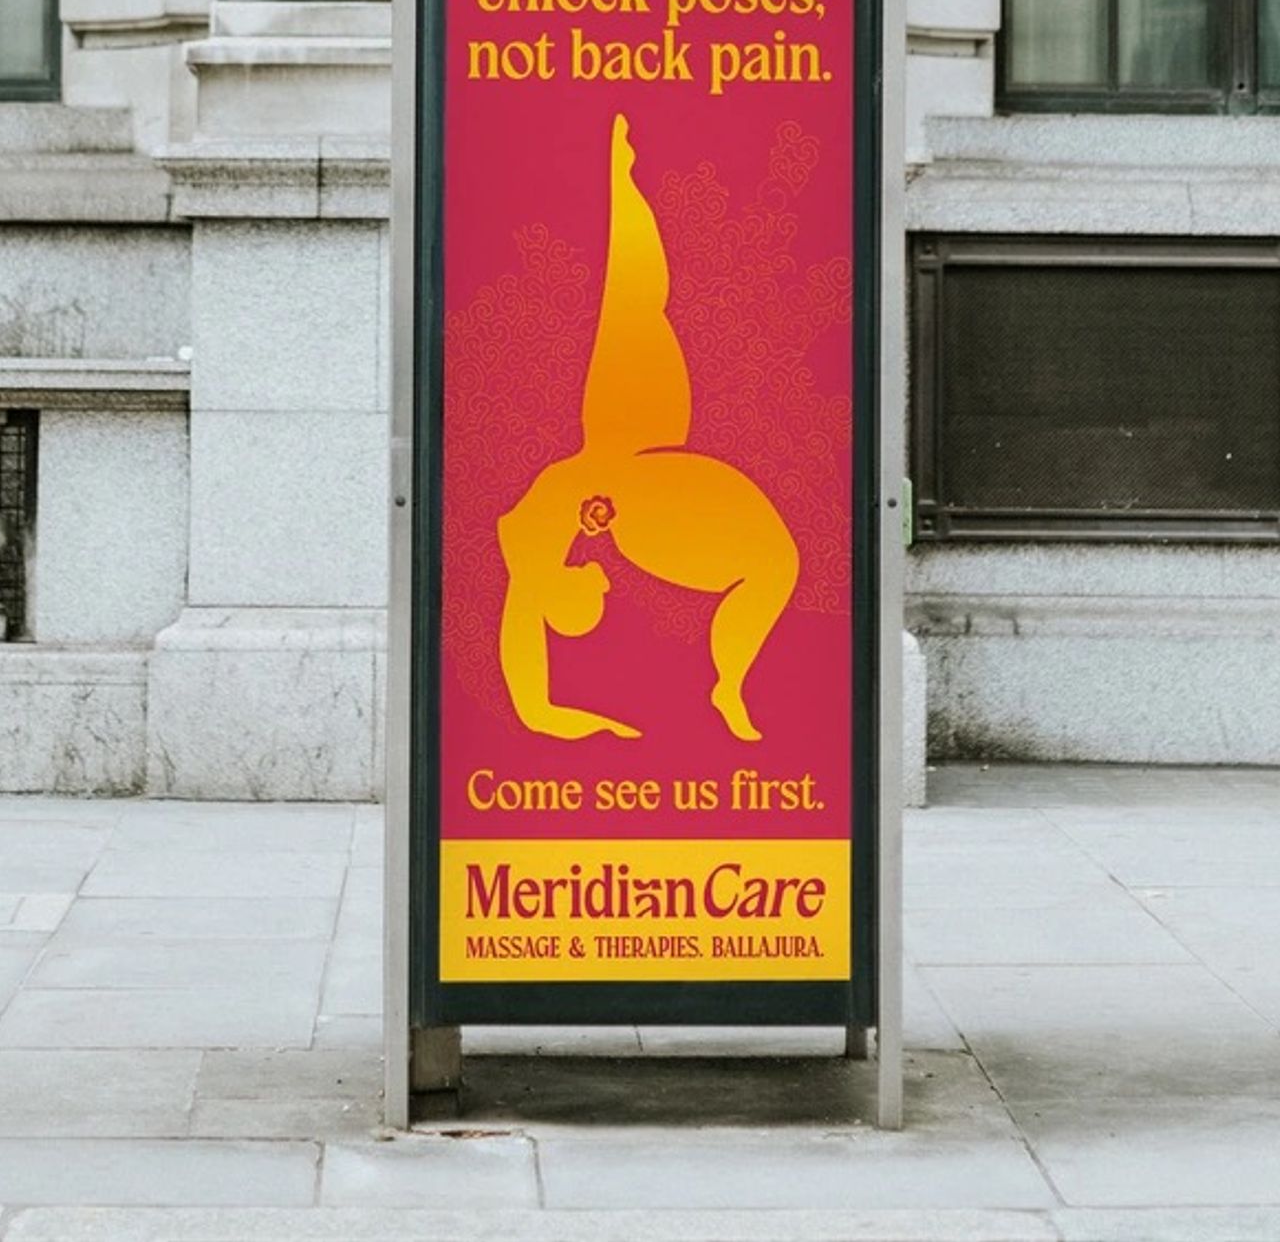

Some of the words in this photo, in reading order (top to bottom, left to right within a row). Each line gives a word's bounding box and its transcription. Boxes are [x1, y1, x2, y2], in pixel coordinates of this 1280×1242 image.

[467, 32, 555, 80] not
[571, 28, 693, 80] back
[709, 30, 832, 95] pain.
[466, 769, 582, 810] Come
[595, 779, 661, 810] see
[673, 779, 719, 810] us
[730, 769, 825, 810] first.
[465, 935, 561, 959] MASSAGE
[568, 935, 586, 959] &
[593, 935, 704, 959] THERAPIES.
[711, 935, 825, 959] BALLAJURA.
